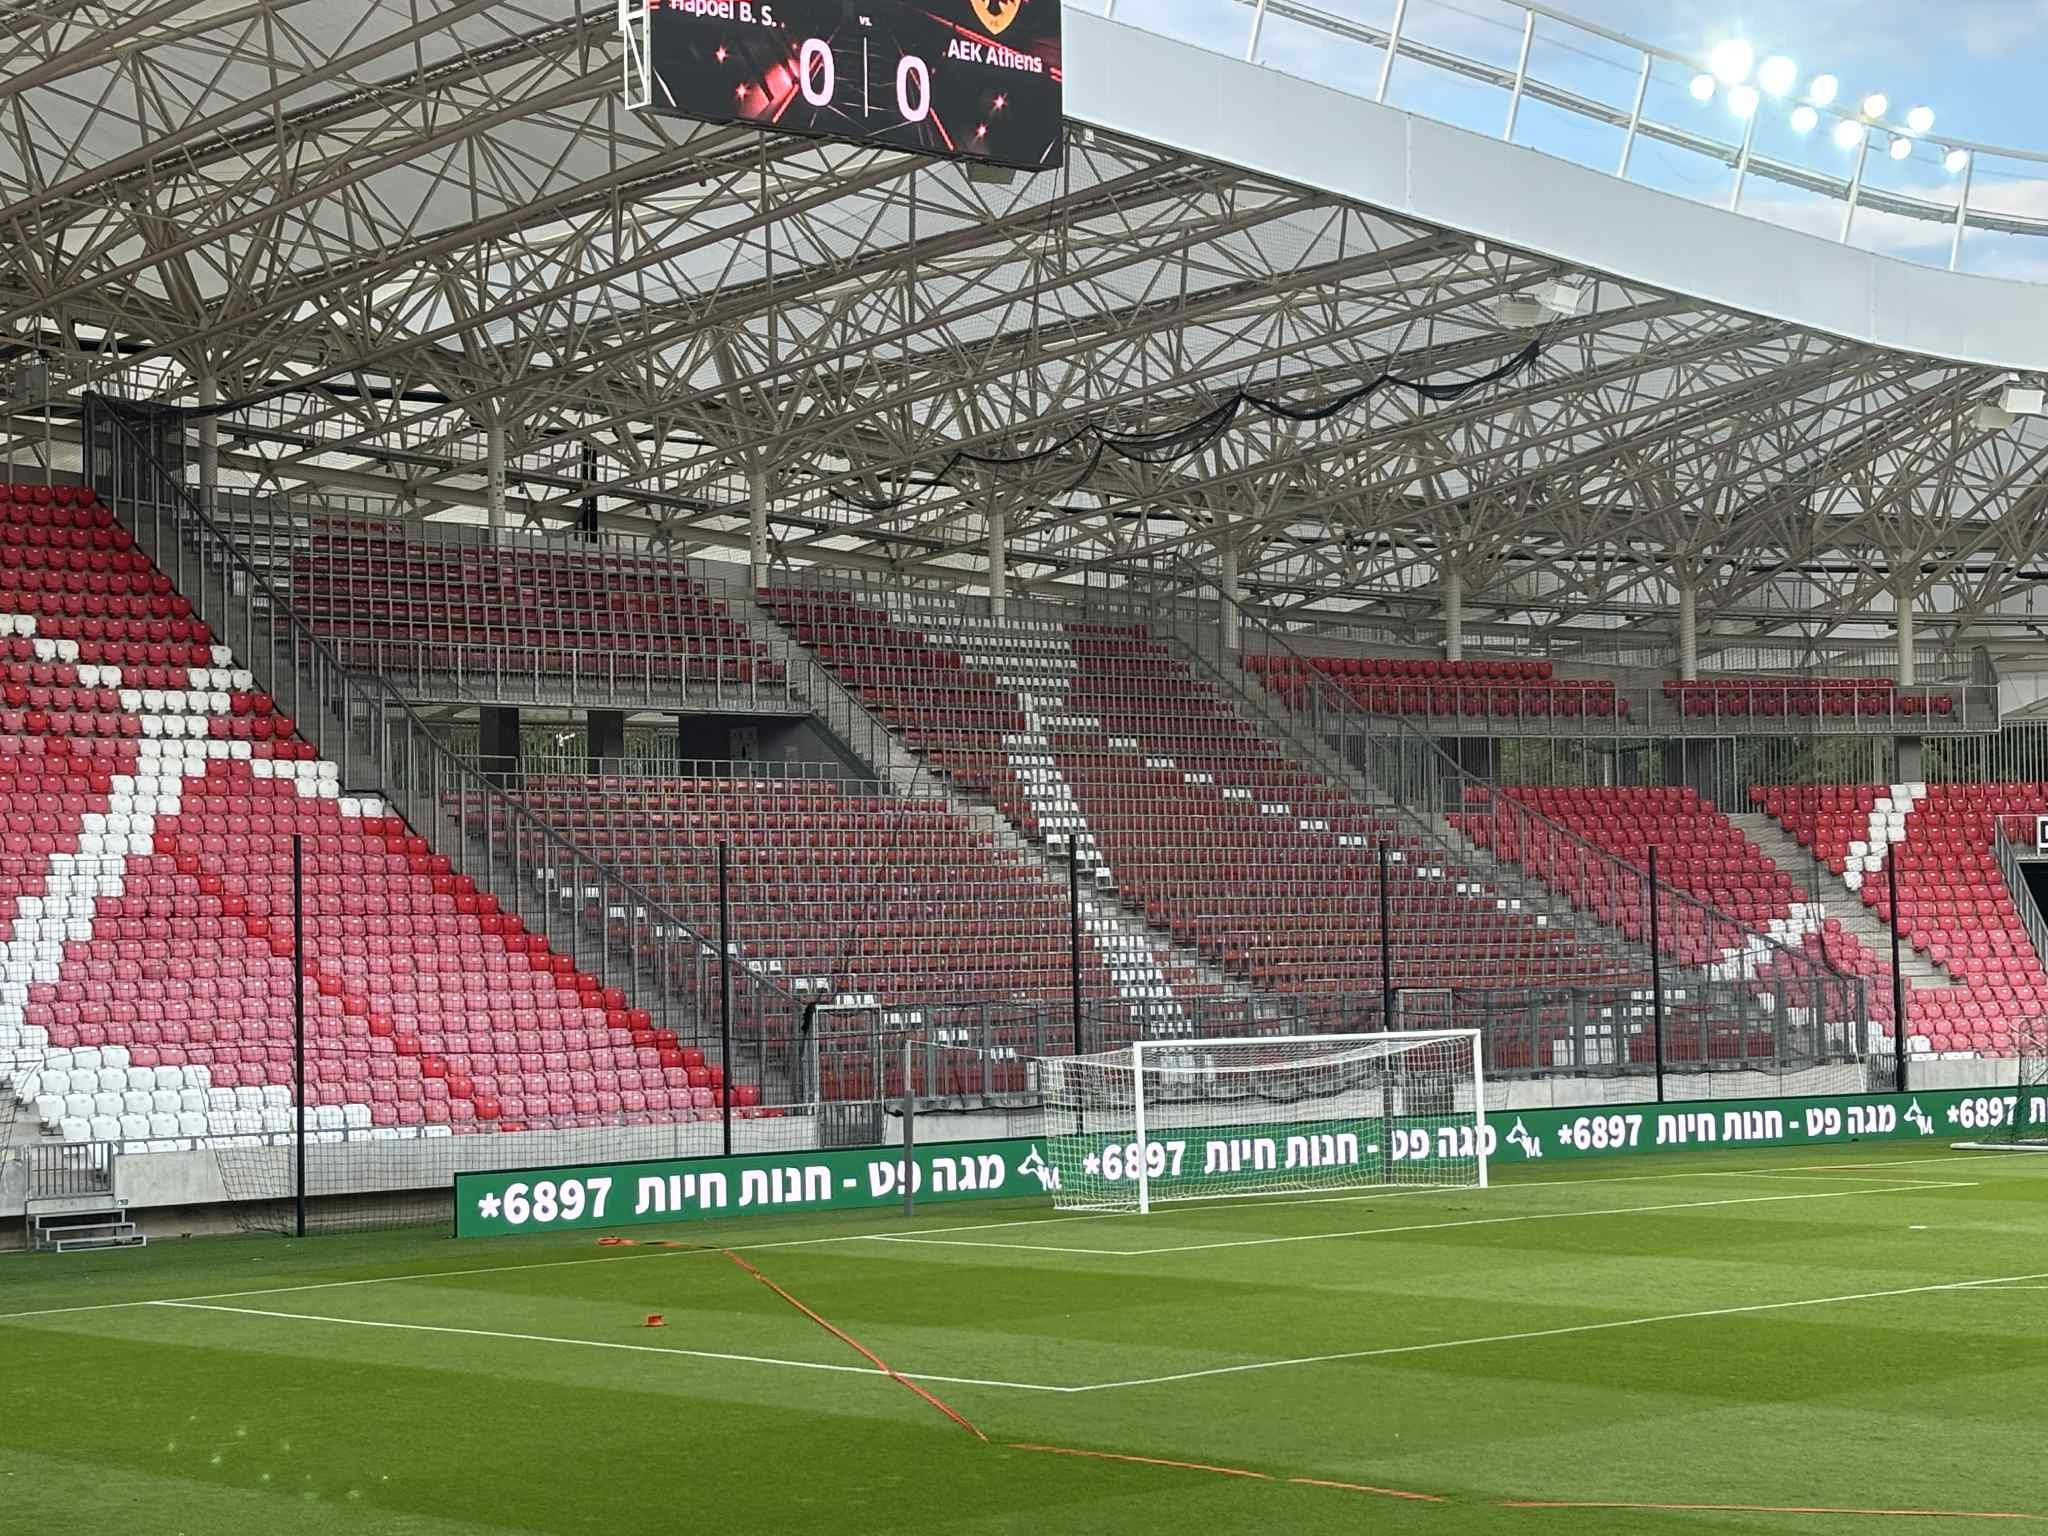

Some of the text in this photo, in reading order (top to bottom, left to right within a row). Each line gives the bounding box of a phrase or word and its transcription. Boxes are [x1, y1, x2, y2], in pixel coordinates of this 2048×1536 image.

[740, 2, 757, 23] B.
[762, 5, 777, 27] S.
[800, 38, 835, 106] 0
[948, 39, 1042, 73] AEK Athens
[896, 55, 930, 122] 0
[1656, 1112, 1716, 1145] חיות
[1722, 1110, 1783, 1141] חנות
[1805, 1107, 1841, 1137] פט
[1847, 1104, 1897, 1134] מגה
[1204, 1138, 1277, 1174] חיות
[1284, 1133, 1359, 1168] חנות
[738, 1165, 832, 1206] חנות
[868, 1160, 922, 1197] פט
[932, 1154, 1005, 1192] מגה
[635, 1172, 727, 1214] חיות
